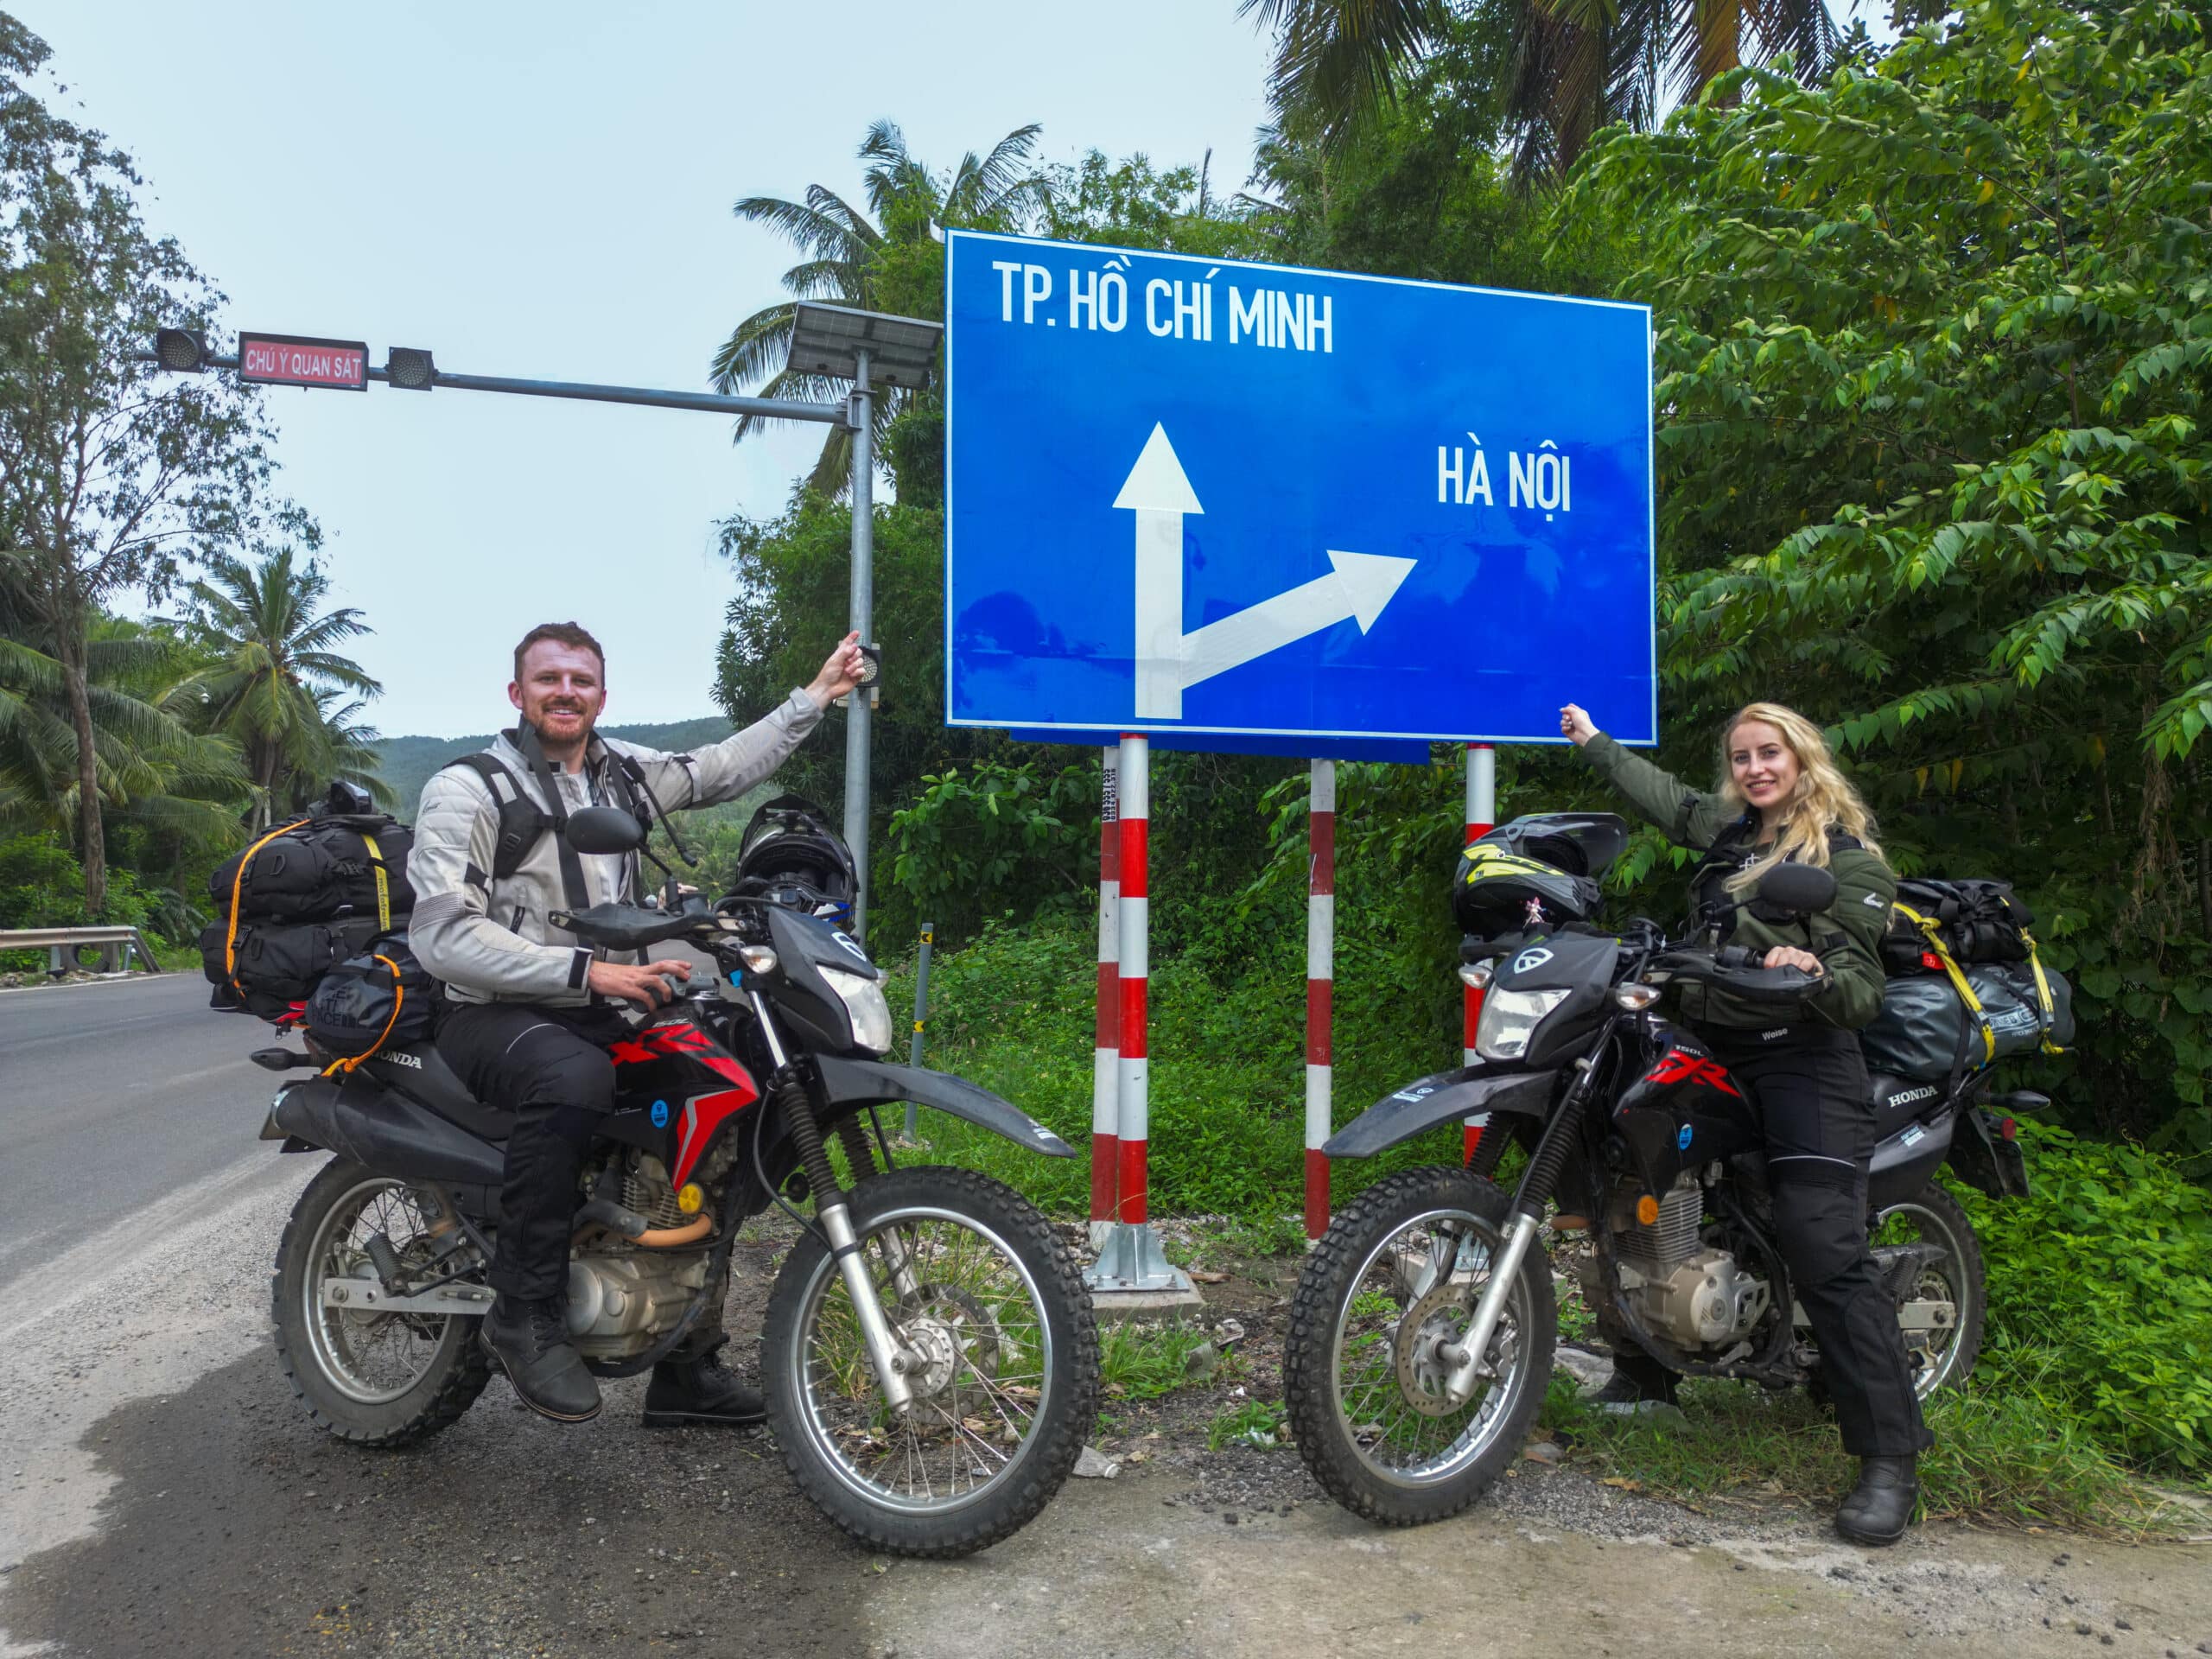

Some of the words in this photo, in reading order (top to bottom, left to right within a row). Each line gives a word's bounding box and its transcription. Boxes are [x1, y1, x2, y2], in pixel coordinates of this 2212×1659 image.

[992, 260, 1055, 327] TP.
[1069, 254, 1132, 333] HỒ
[1146, 267, 1221, 342] CHÍ
[1229, 285, 1332, 353] MINH
[246, 347, 275, 372] CHÚ
[279, 347, 289, 374] Ý
[292, 353, 330, 378] QUAN
[334, 353, 361, 379] SÁT
[1438, 431, 1494, 506] HÀ
[1509, 439, 1571, 522] NỘI
[1762, 1027, 1788, 1041] Weise
[373, 1051, 423, 1070] ONDA
[1888, 1085, 1938, 1108] HONDA
